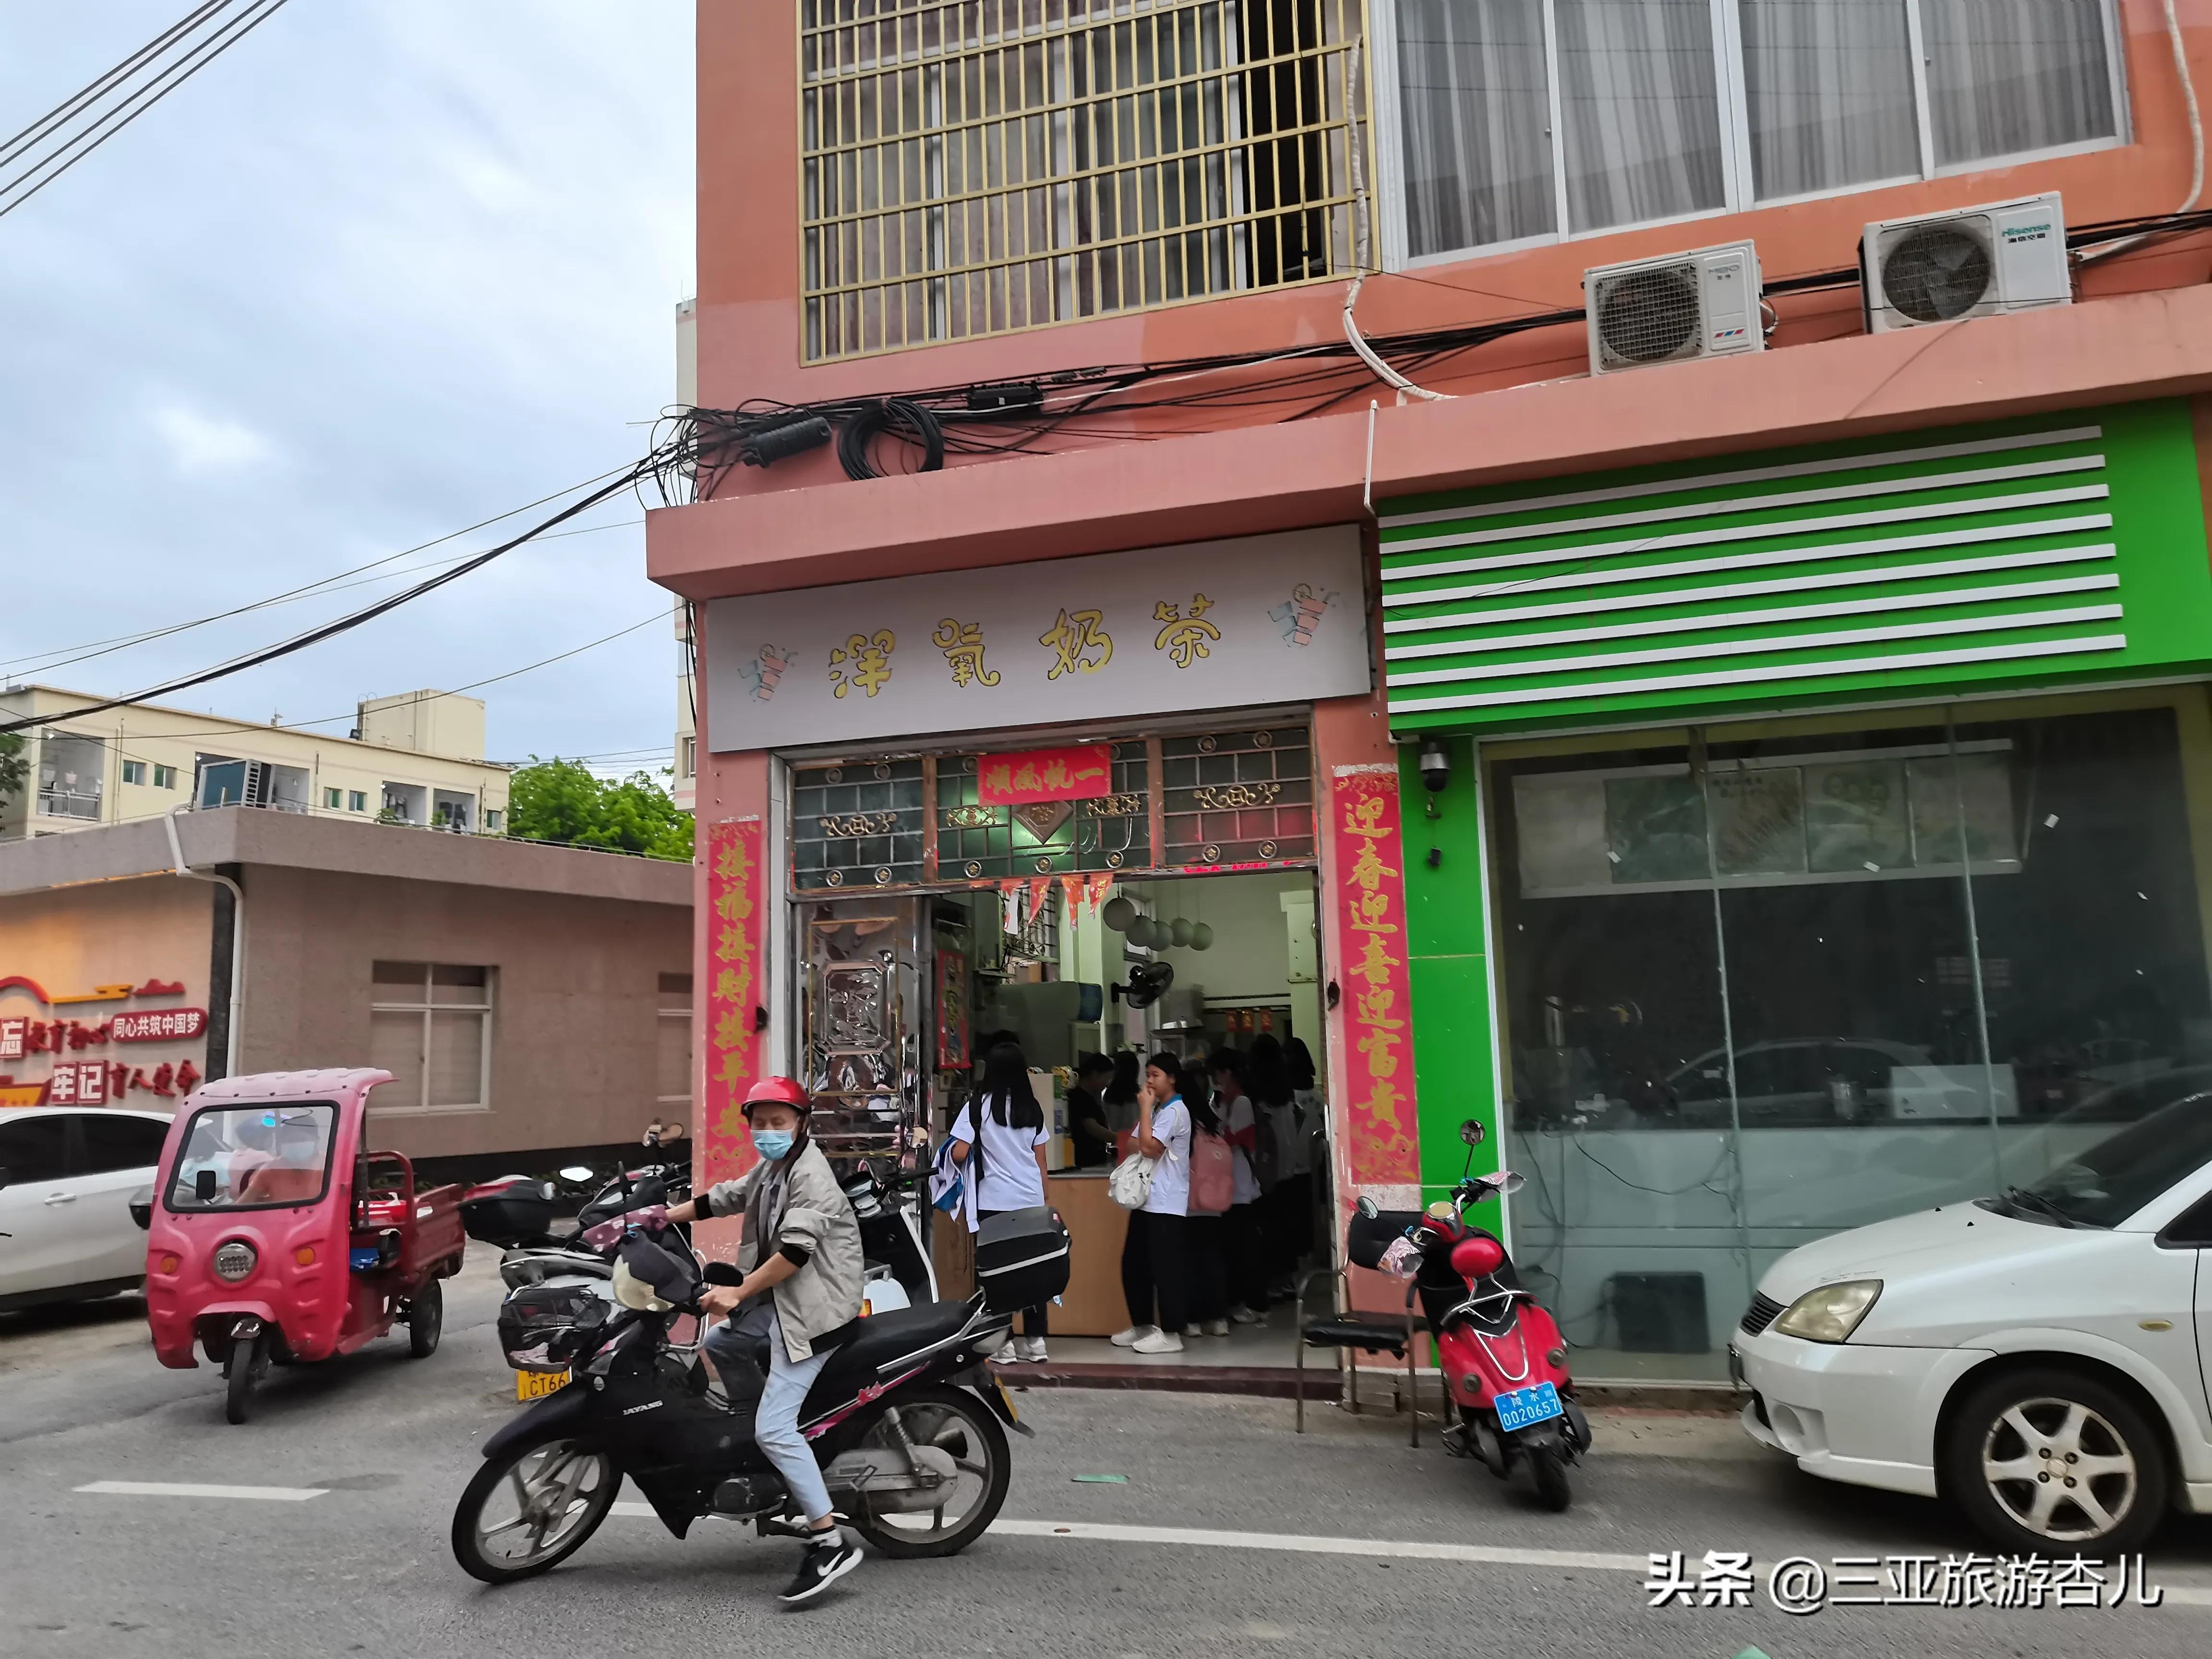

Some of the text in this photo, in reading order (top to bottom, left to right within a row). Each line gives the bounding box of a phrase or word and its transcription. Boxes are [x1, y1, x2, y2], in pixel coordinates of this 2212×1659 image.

[829, 593, 1221, 699] 洋氧奶茶
[113, 1012, 200, 1038] 同心共筑中国梦
[1503, 1399, 1558, 1426] 0020657
